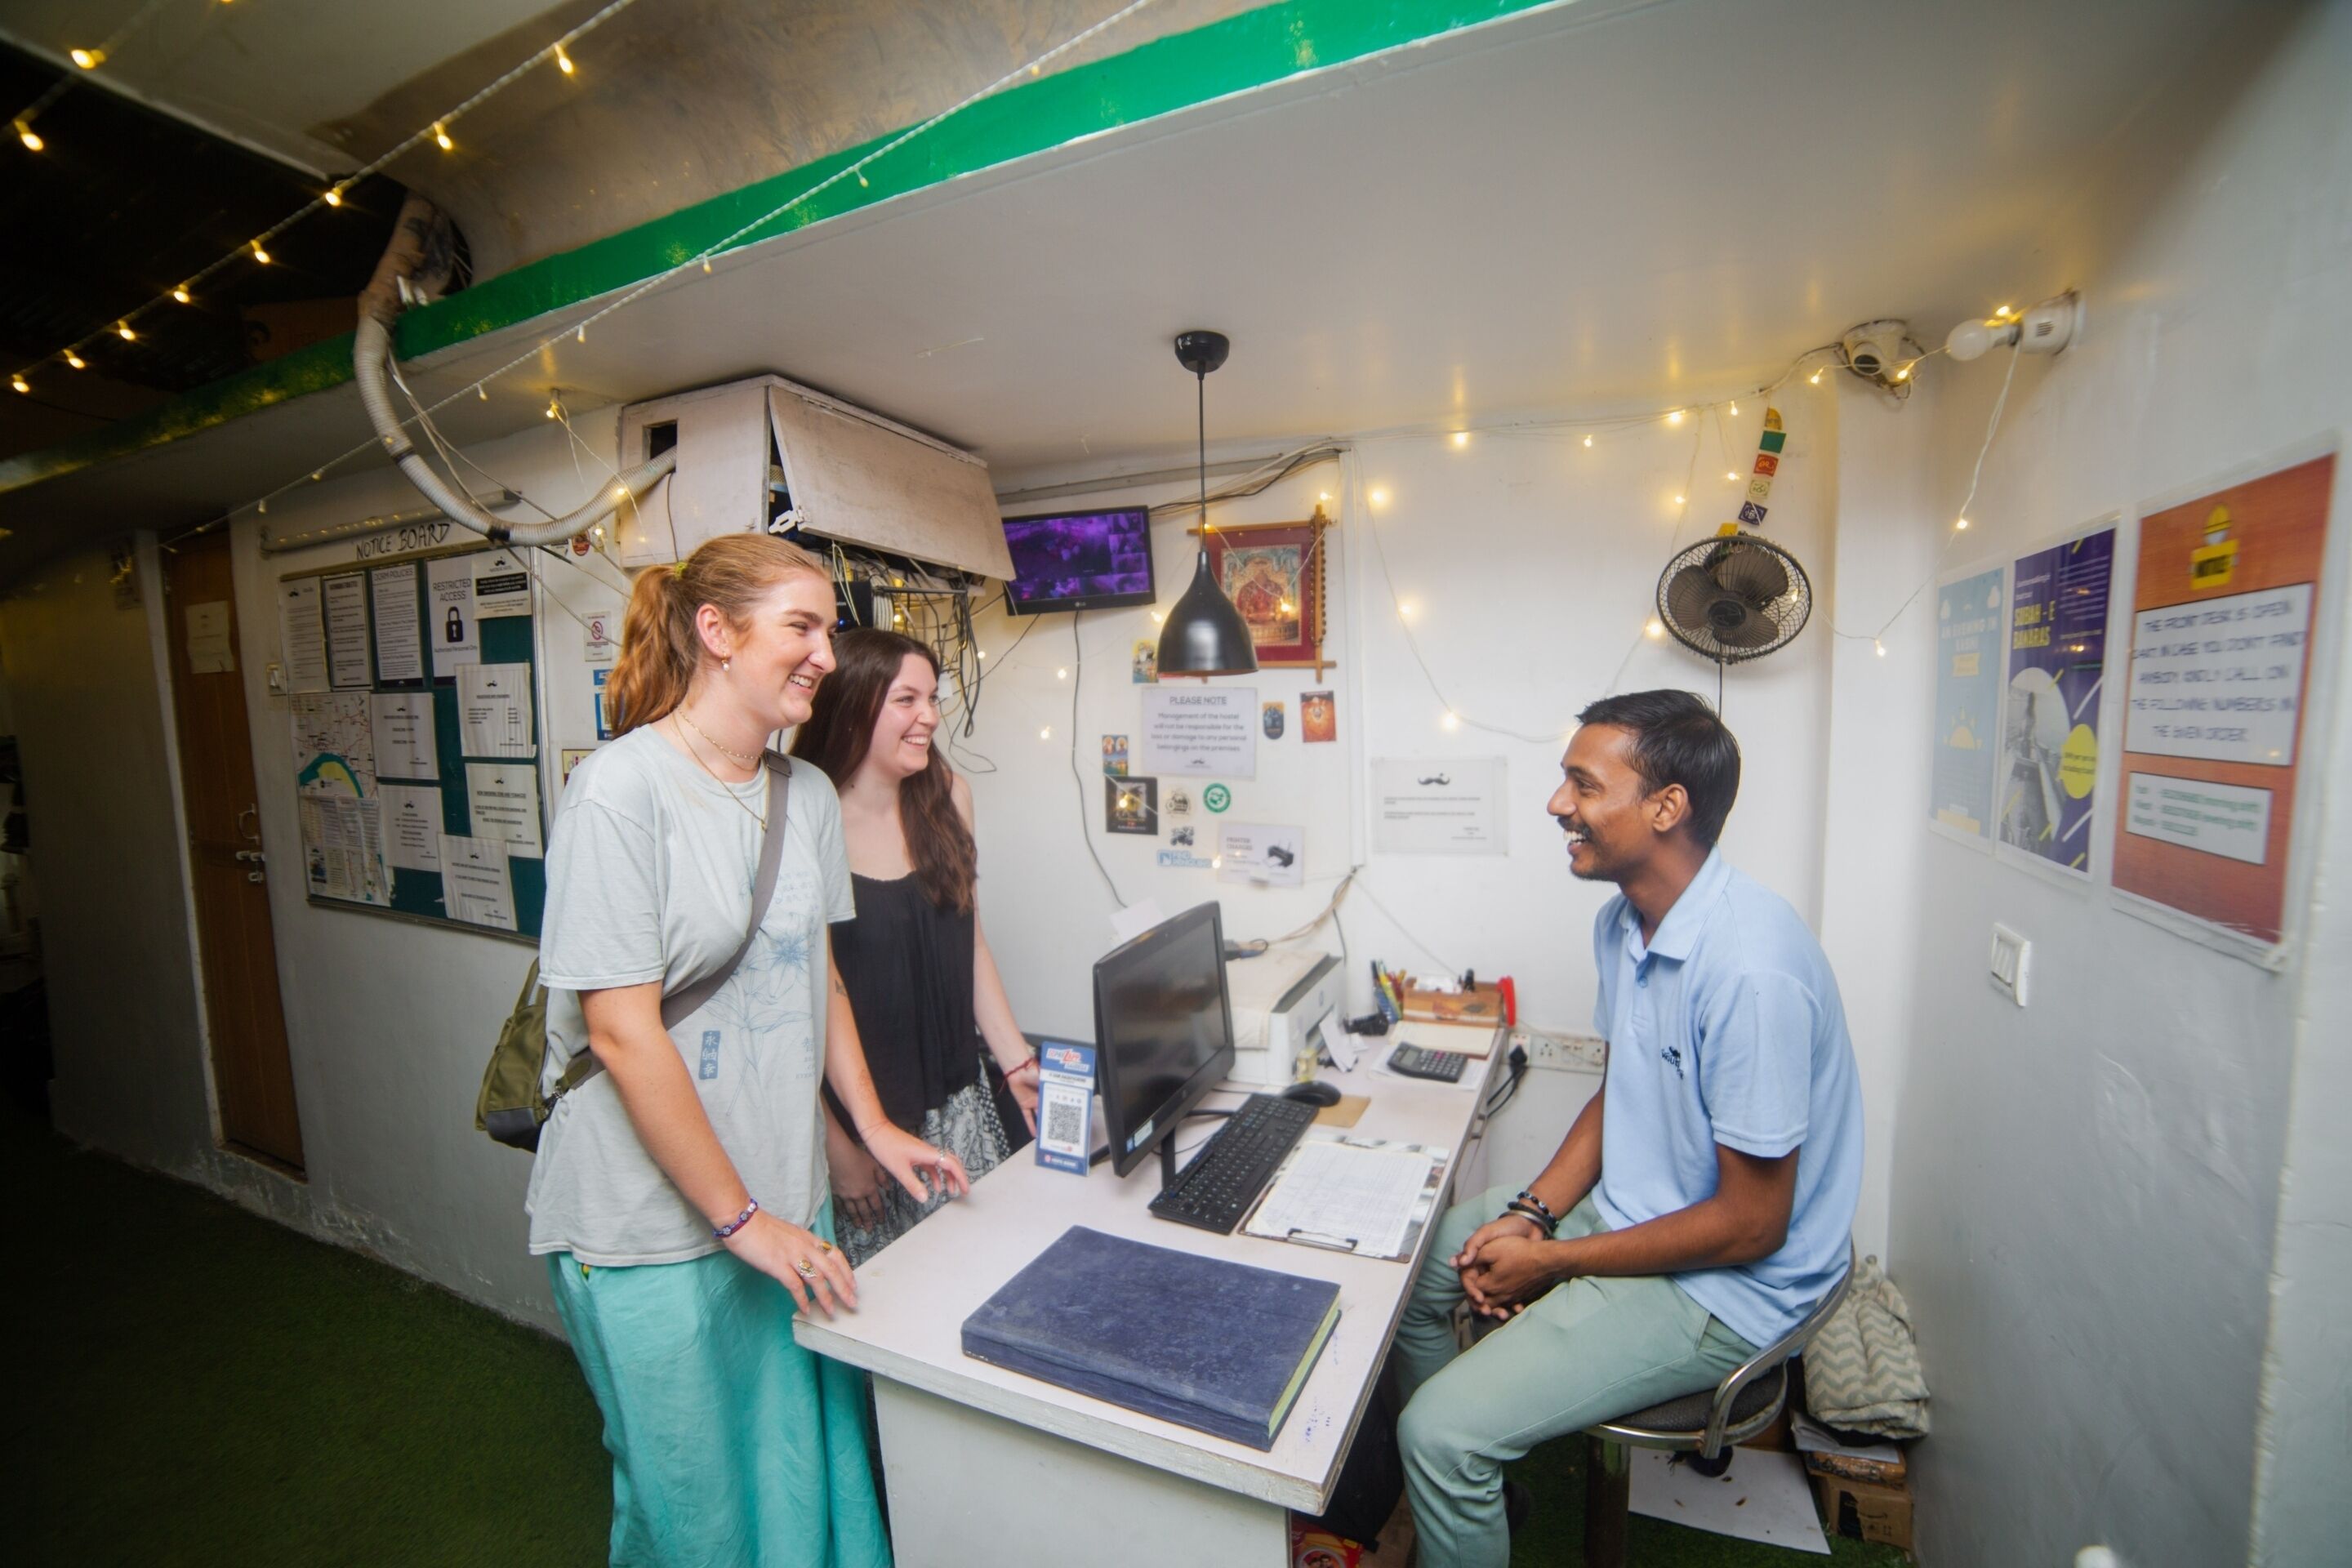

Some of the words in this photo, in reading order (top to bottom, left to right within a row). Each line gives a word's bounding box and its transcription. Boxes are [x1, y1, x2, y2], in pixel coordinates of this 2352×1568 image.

[356, 535, 391, 560] NOTICE
[398, 523, 450, 552] BOARD
[432, 577, 472, 591] RESTRICTED
[439, 590, 466, 602] ACCESS
[1169, 696, 1202, 704] PLEASE
[1204, 696, 1227, 704] NOTE
[1158, 712, 1199, 720] Management
[1185, 723, 1221, 731] responsible
[1172, 733, 1196, 742] damage
